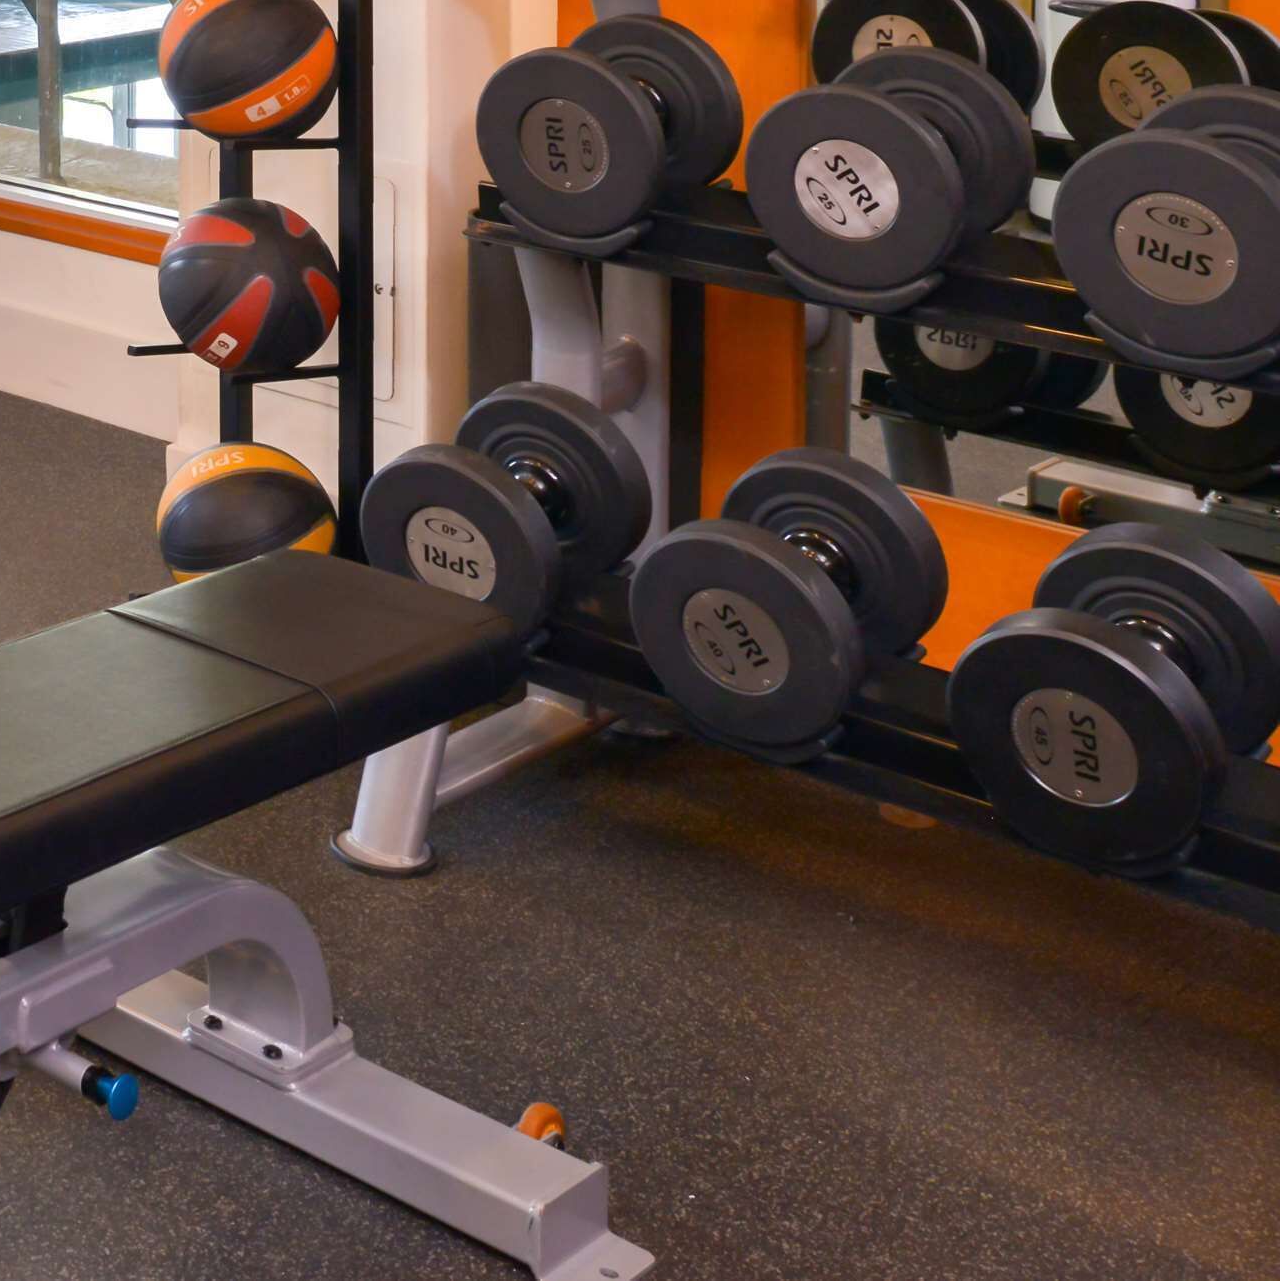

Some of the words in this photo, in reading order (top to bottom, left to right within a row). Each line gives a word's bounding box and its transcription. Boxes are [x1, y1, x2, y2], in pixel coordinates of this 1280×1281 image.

[256, 105, 268, 117] 4
[545, 116, 568, 174] SPRI
[581, 138, 592, 156] 25
[824, 154, 880, 218] SPRI
[817, 192, 835, 212] 25
[1166, 212, 1190, 229] 30
[1135, 234, 1215, 277] SPRI
[191, 451, 245, 479] SPRI
[440, 522, 458, 536] 40
[422, 542, 481, 581] SPRI
[712, 604, 771, 669] SPRI
[704, 640, 723, 658] 40
[1034, 727, 1045, 745] 45
[1068, 710, 1101, 784] SPRI
